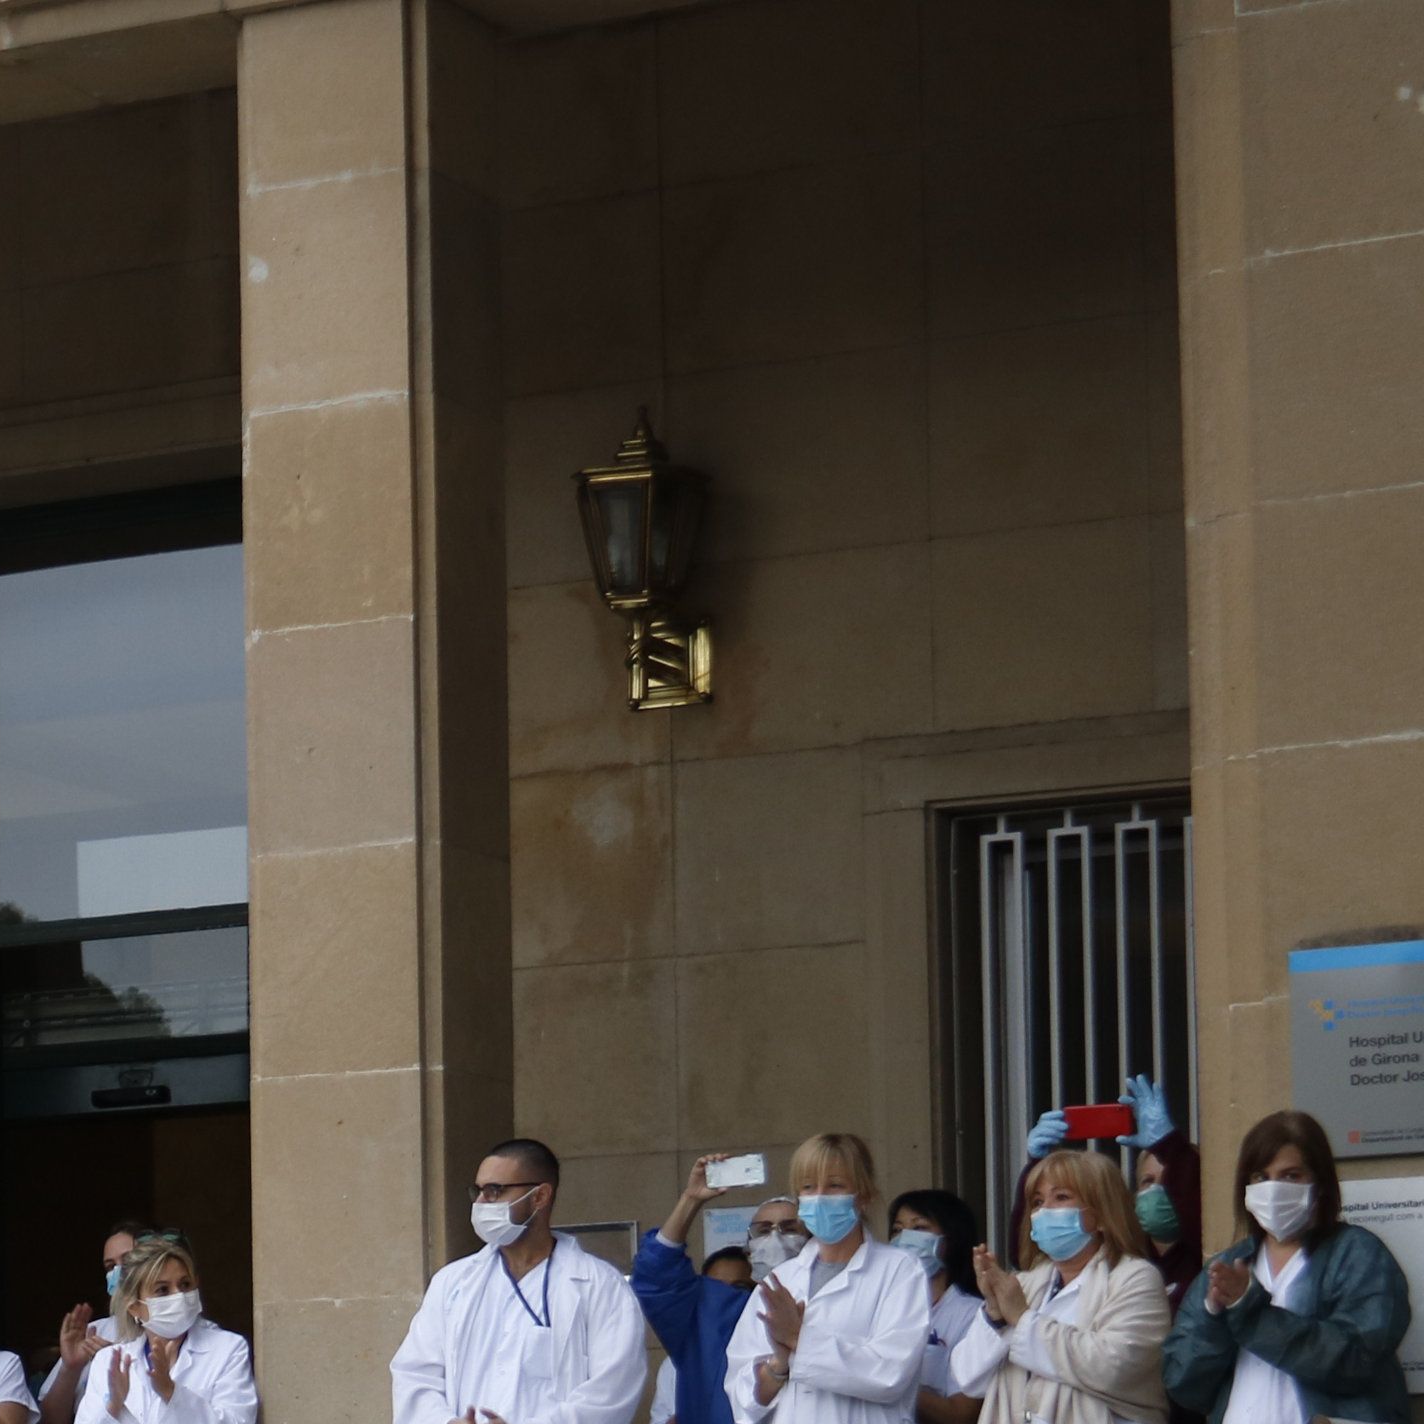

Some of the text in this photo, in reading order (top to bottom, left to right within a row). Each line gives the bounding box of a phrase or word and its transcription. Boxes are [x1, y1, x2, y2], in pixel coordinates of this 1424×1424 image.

[1349, 1032, 1409, 1048] Hospital
[1350, 1053, 1419, 1067] de Girona
[1350, 1073, 1399, 1086] Doctor
